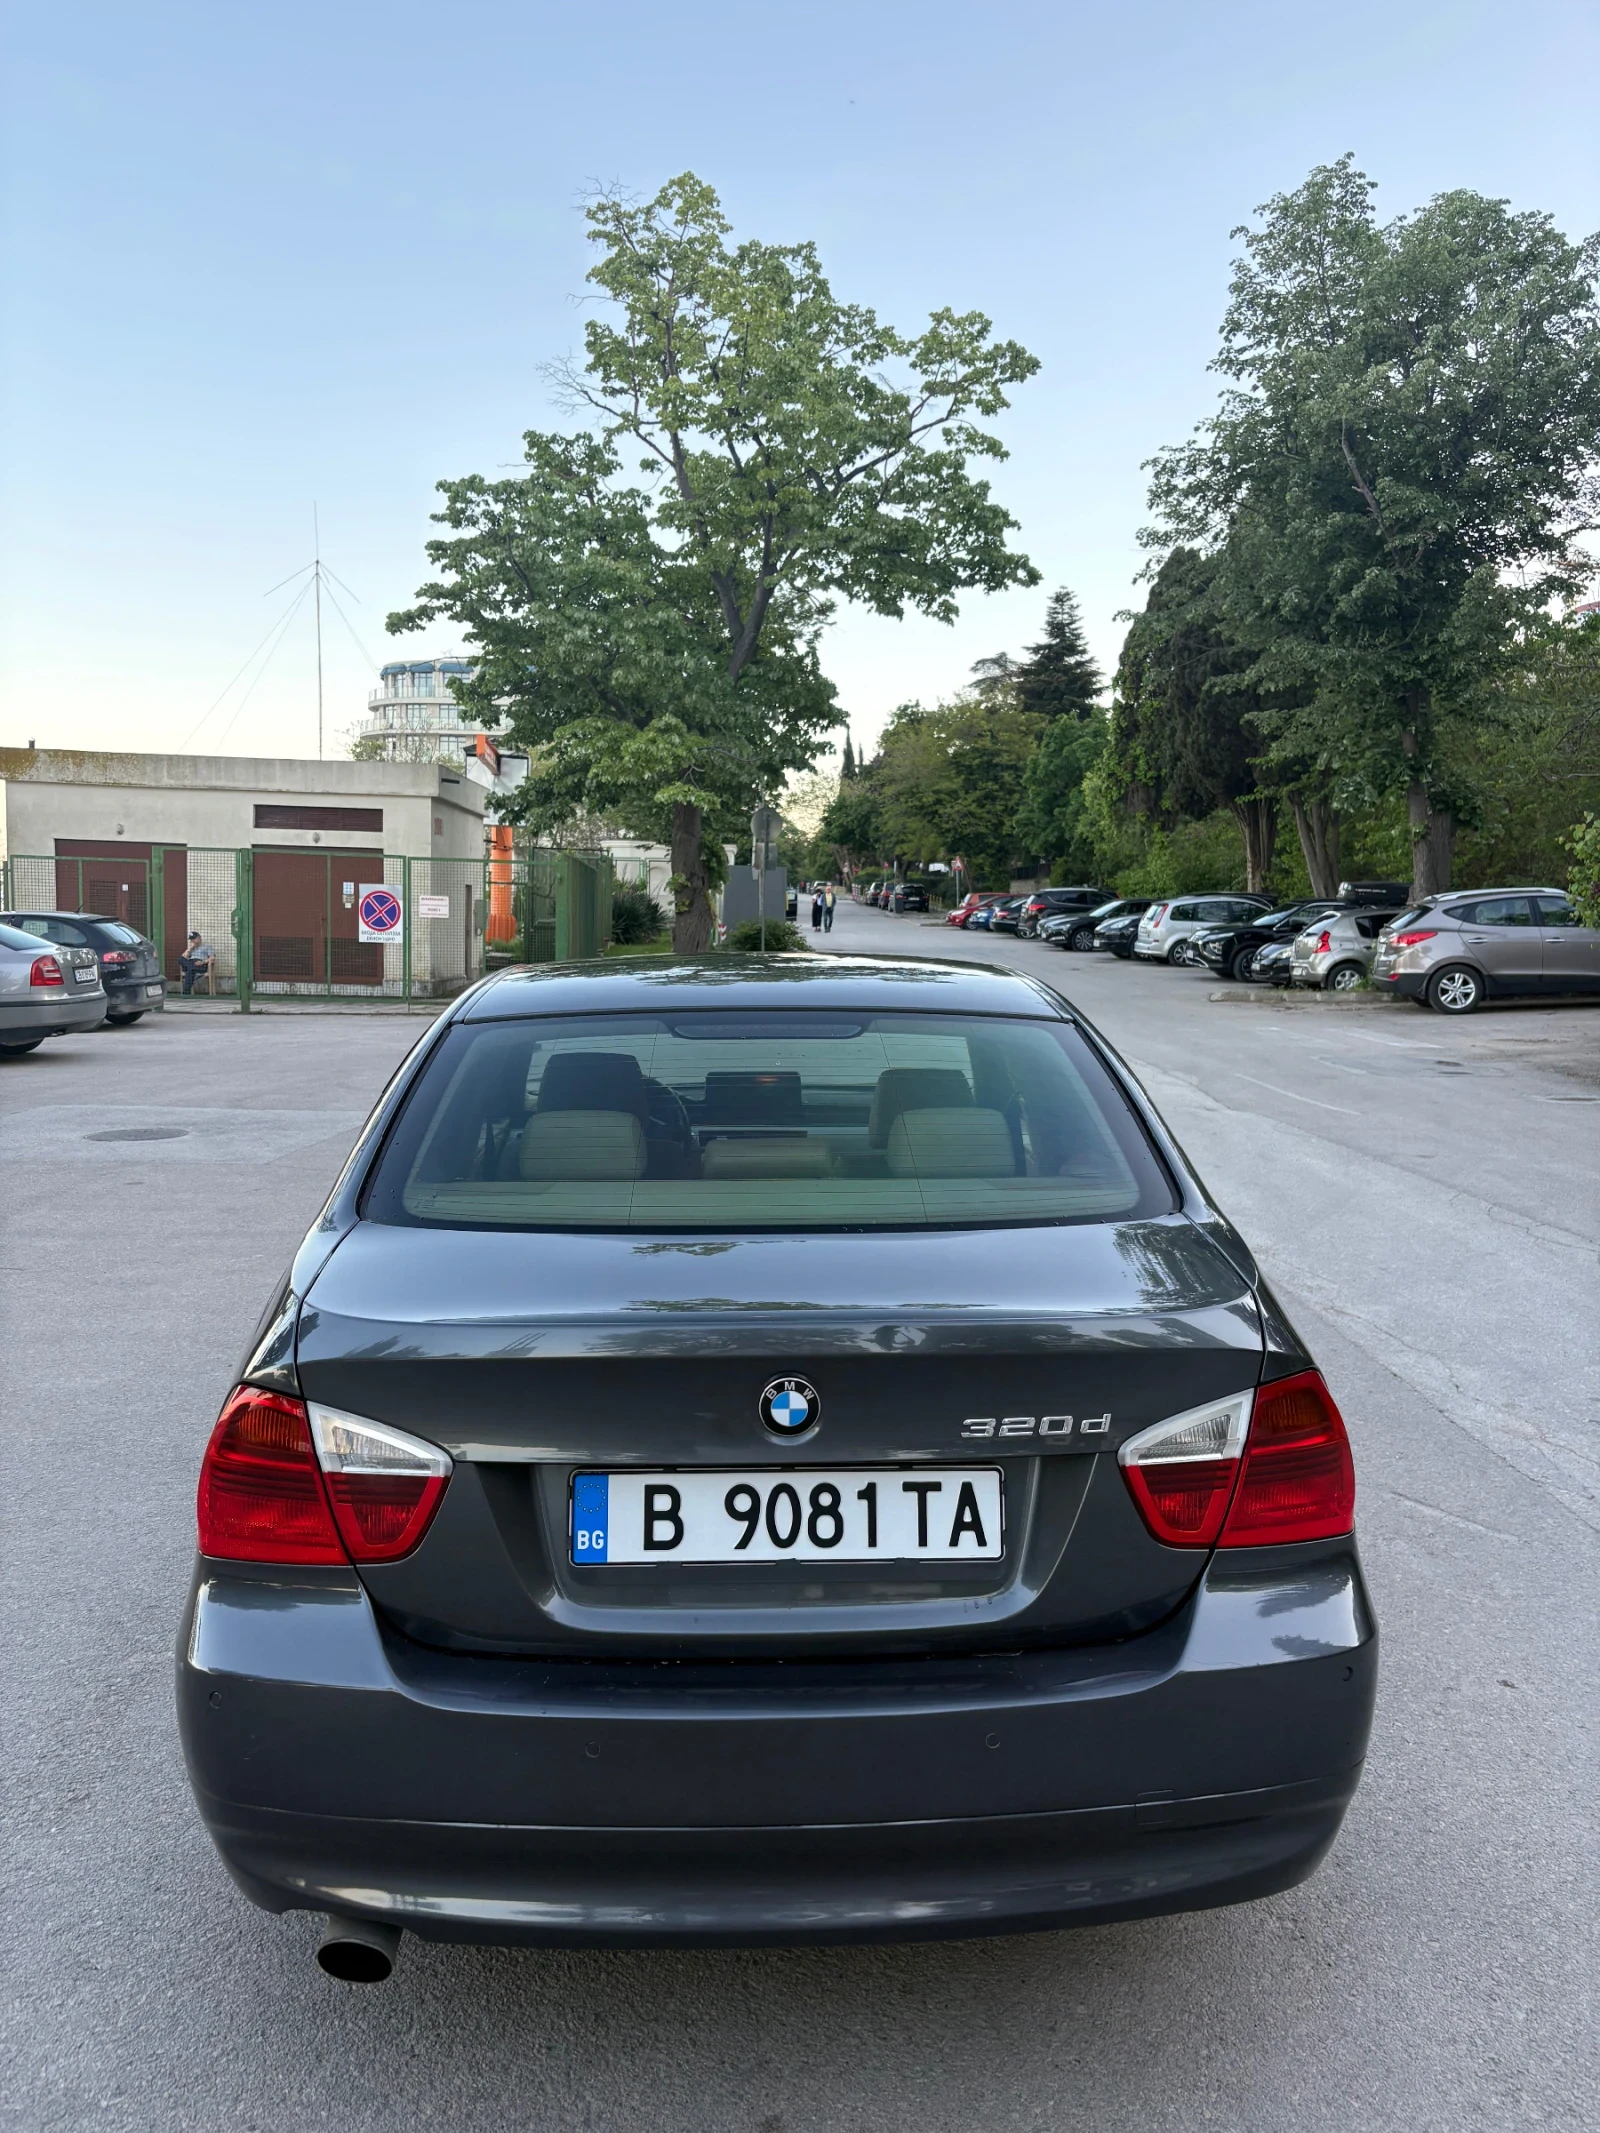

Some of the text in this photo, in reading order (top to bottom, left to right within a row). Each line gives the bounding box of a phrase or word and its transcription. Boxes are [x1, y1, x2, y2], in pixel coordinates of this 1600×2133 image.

[765, 1381, 815, 1401] BMW
[960, 1413, 1112, 1438] 320d
[643, 1484, 684, 1551] B
[576, 1529, 606, 1551] BG
